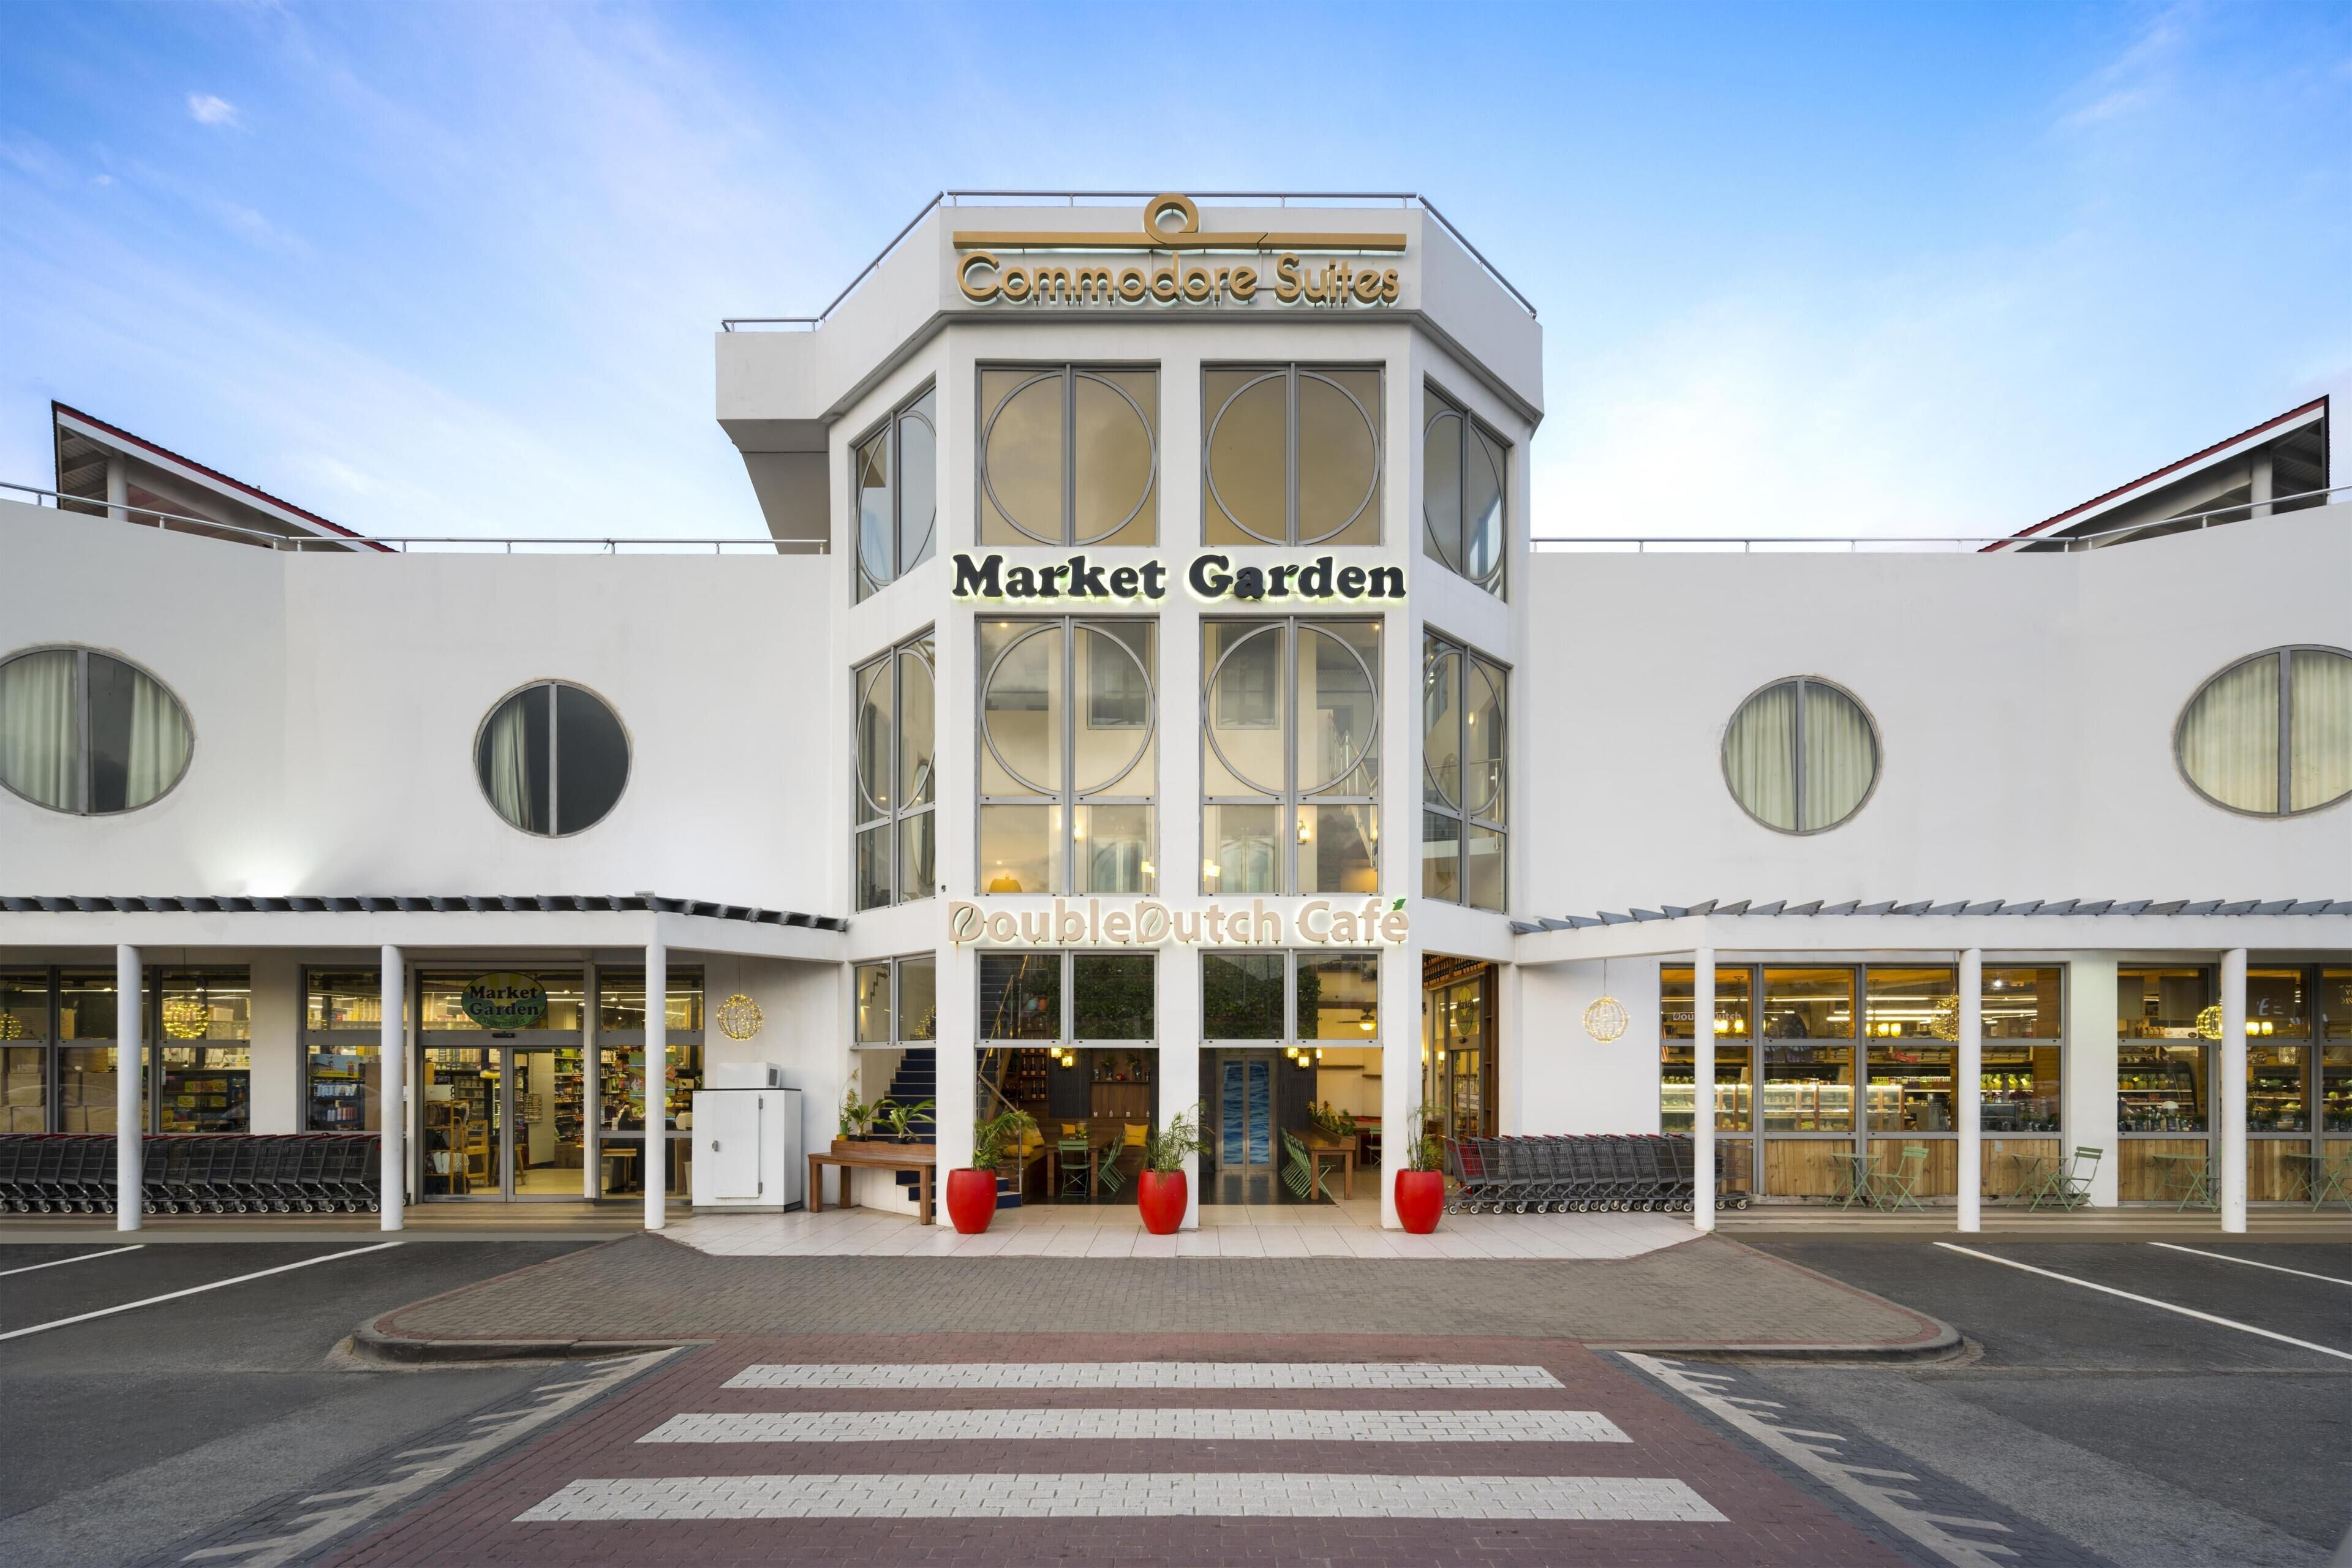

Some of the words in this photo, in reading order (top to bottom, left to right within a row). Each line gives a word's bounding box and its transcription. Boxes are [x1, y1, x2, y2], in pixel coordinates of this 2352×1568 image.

[957, 251, 1257, 302] Commodore
[1275, 252, 1400, 303] Suites
[952, 554, 1166, 599] Market
[1189, 554, 1406, 600] Garden
[949, 899, 1281, 942] DoubleDutch
[1298, 898, 1409, 942] Café
[469, 986, 538, 999] Market
[469, 1002, 539, 1016] Garden
